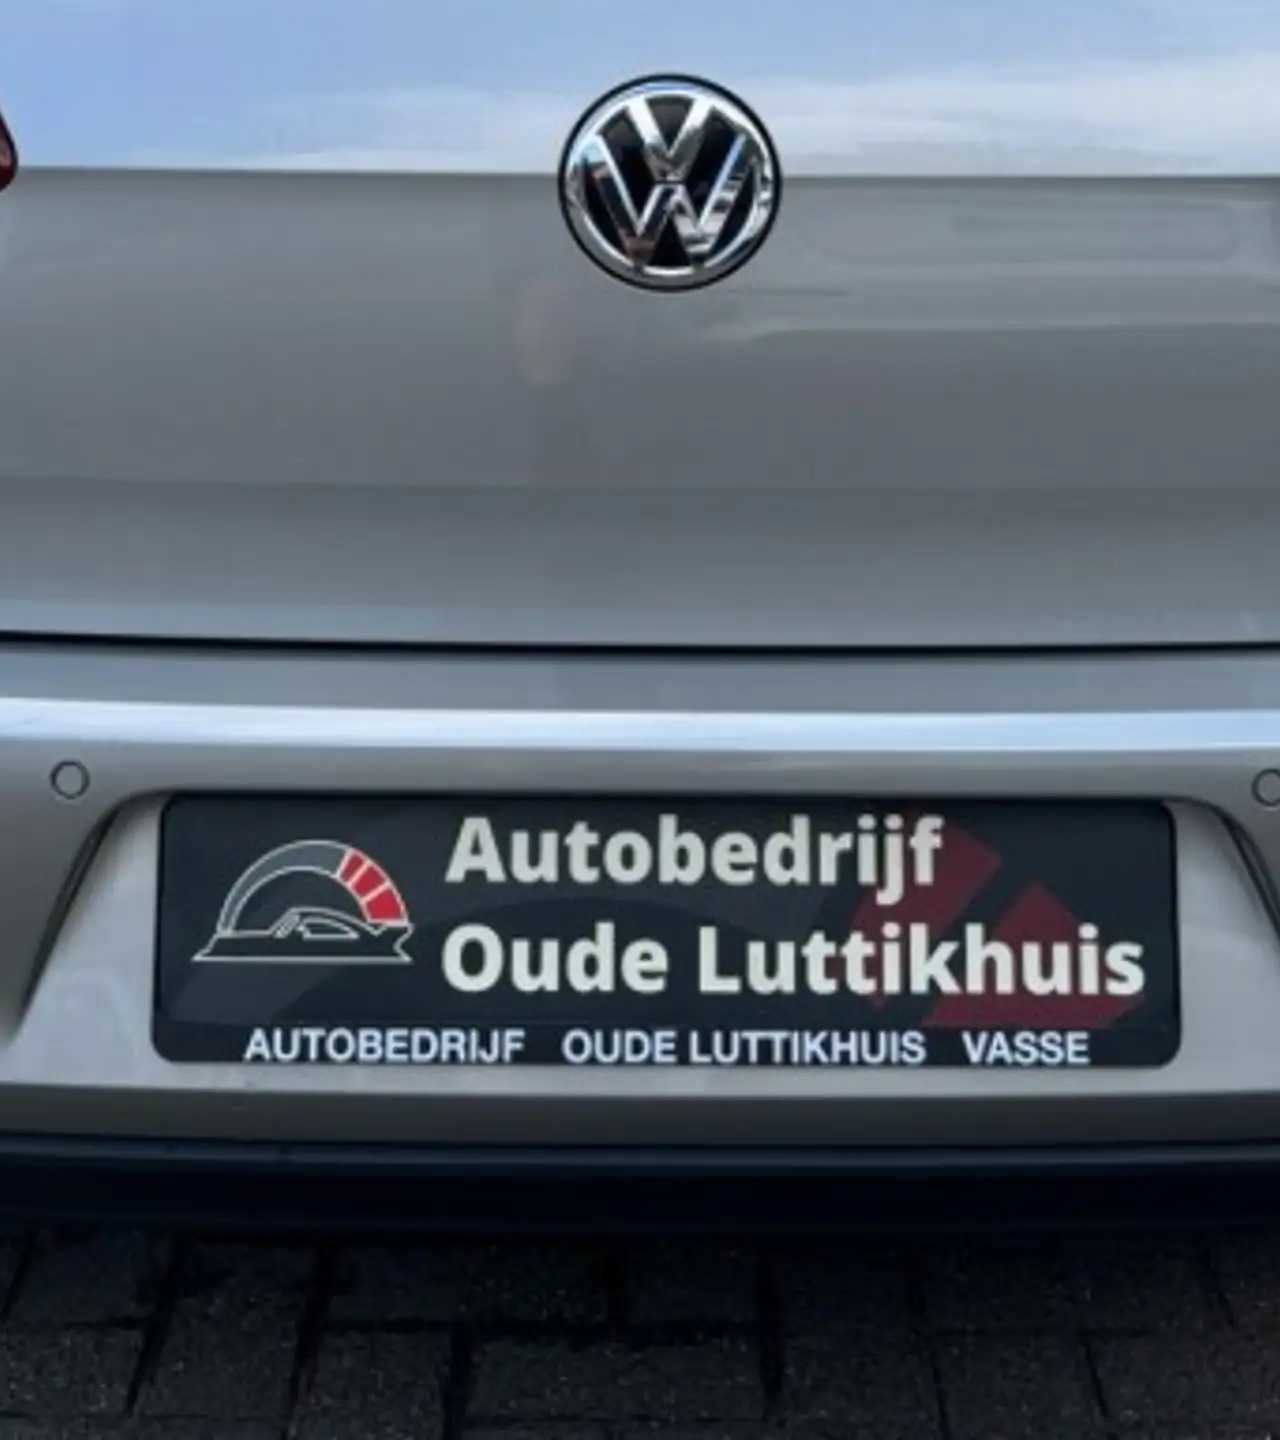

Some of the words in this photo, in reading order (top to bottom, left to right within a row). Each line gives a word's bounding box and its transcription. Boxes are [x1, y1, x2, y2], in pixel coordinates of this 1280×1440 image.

[445, 814, 944, 906] Autobedrijf
[441, 920, 670, 995] Oude
[699, 920, 1146, 997] Luttikhuis
[243, 1027, 525, 1064] AUTOBEDRIJF
[562, 1029, 678, 1066] OUDE
[689, 1029, 928, 1066] LUTTIKHUIS
[961, 1030, 1091, 1067] VASSE
